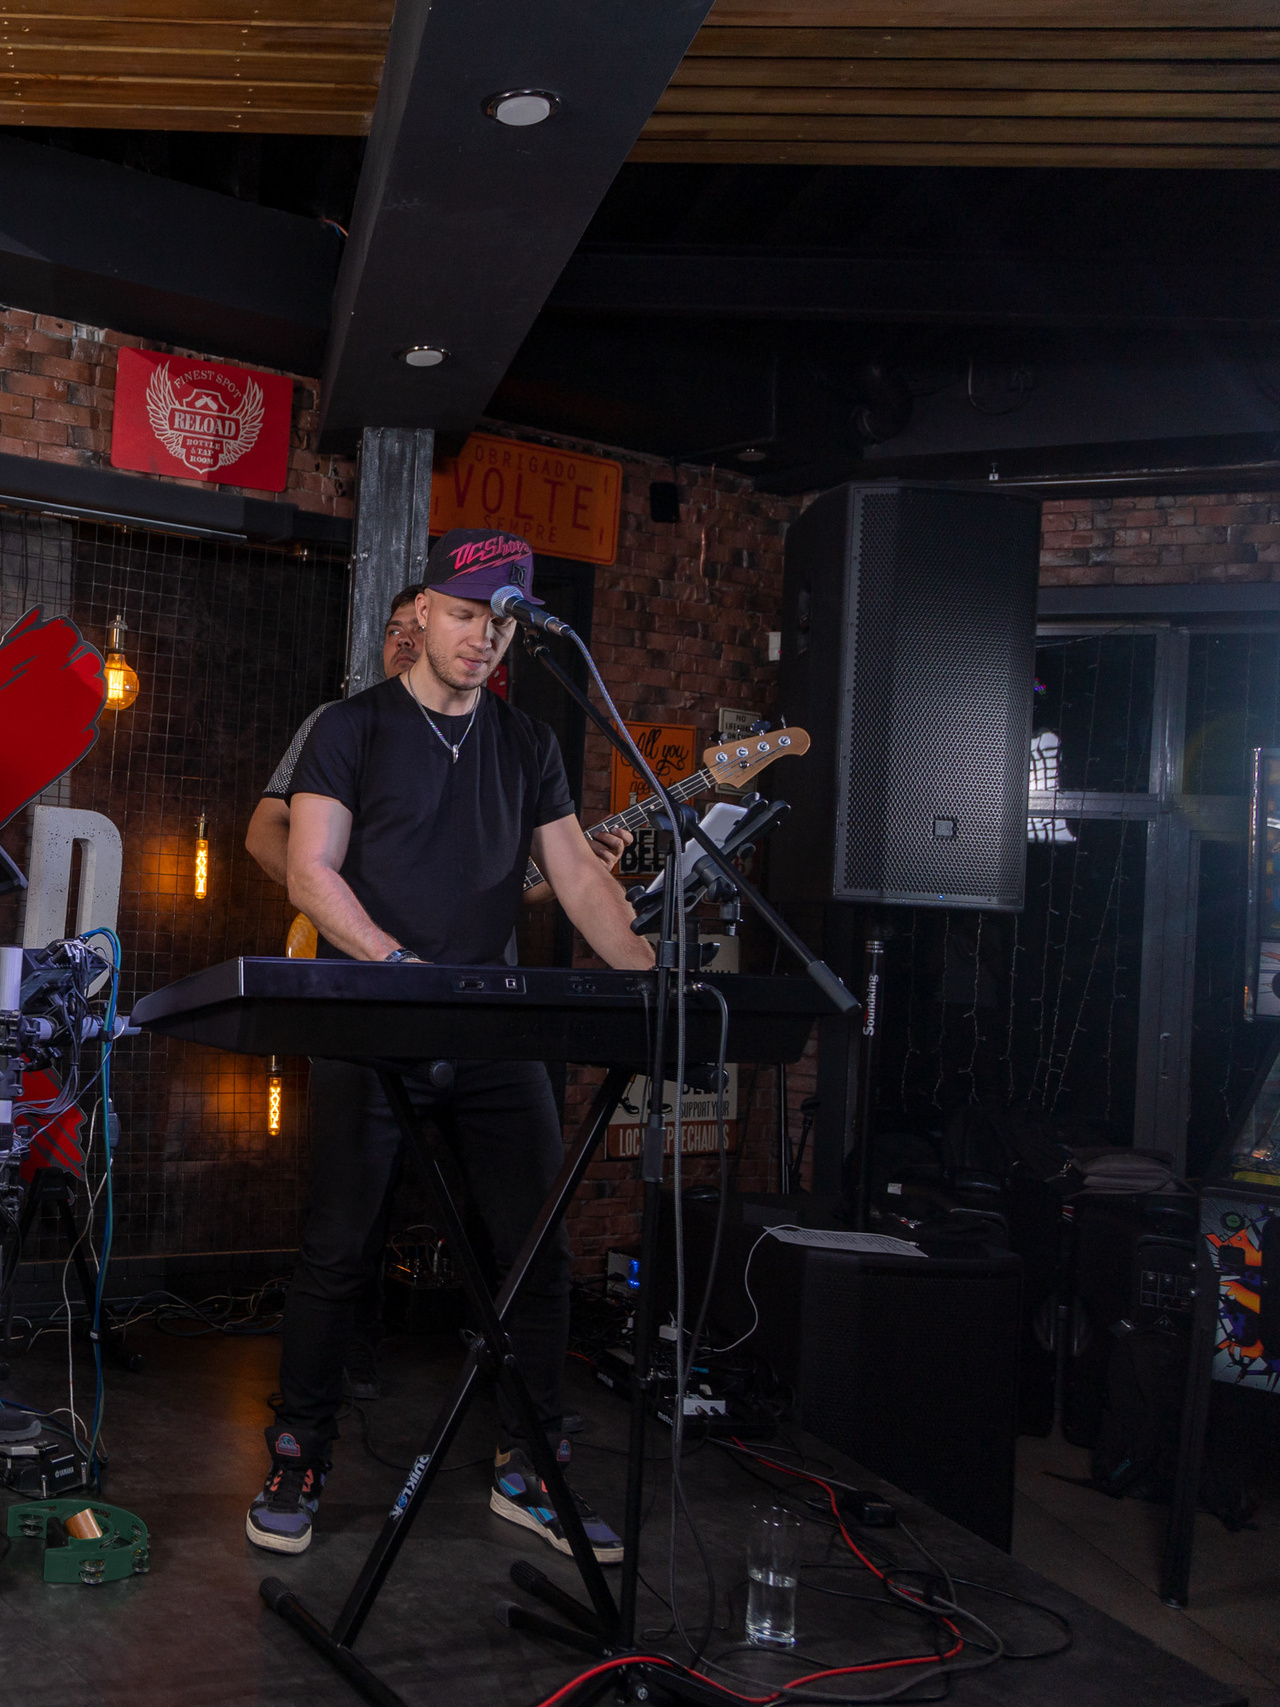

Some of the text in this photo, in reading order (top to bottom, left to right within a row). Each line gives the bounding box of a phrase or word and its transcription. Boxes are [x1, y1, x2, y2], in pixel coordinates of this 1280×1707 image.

[174, 370, 241, 399] FINEST SPOT
[174, 411, 236, 437] RELOAD
[186, 438, 220, 451] BOTTLE
[197, 448, 214, 457] TAP
[190, 455, 214, 465] ROOM
[475, 444, 576, 480] OBRIGADO
[453, 460, 593, 531] VOLTE
[483, 514, 557, 543] SEMPRE
[736, 714, 747, 723] NO
[658, 744, 689, 774] you
[629, 781, 652, 796] nee
[862, 973, 879, 1036] Soundking
[680, 1102, 711, 1118] SUPPORT
